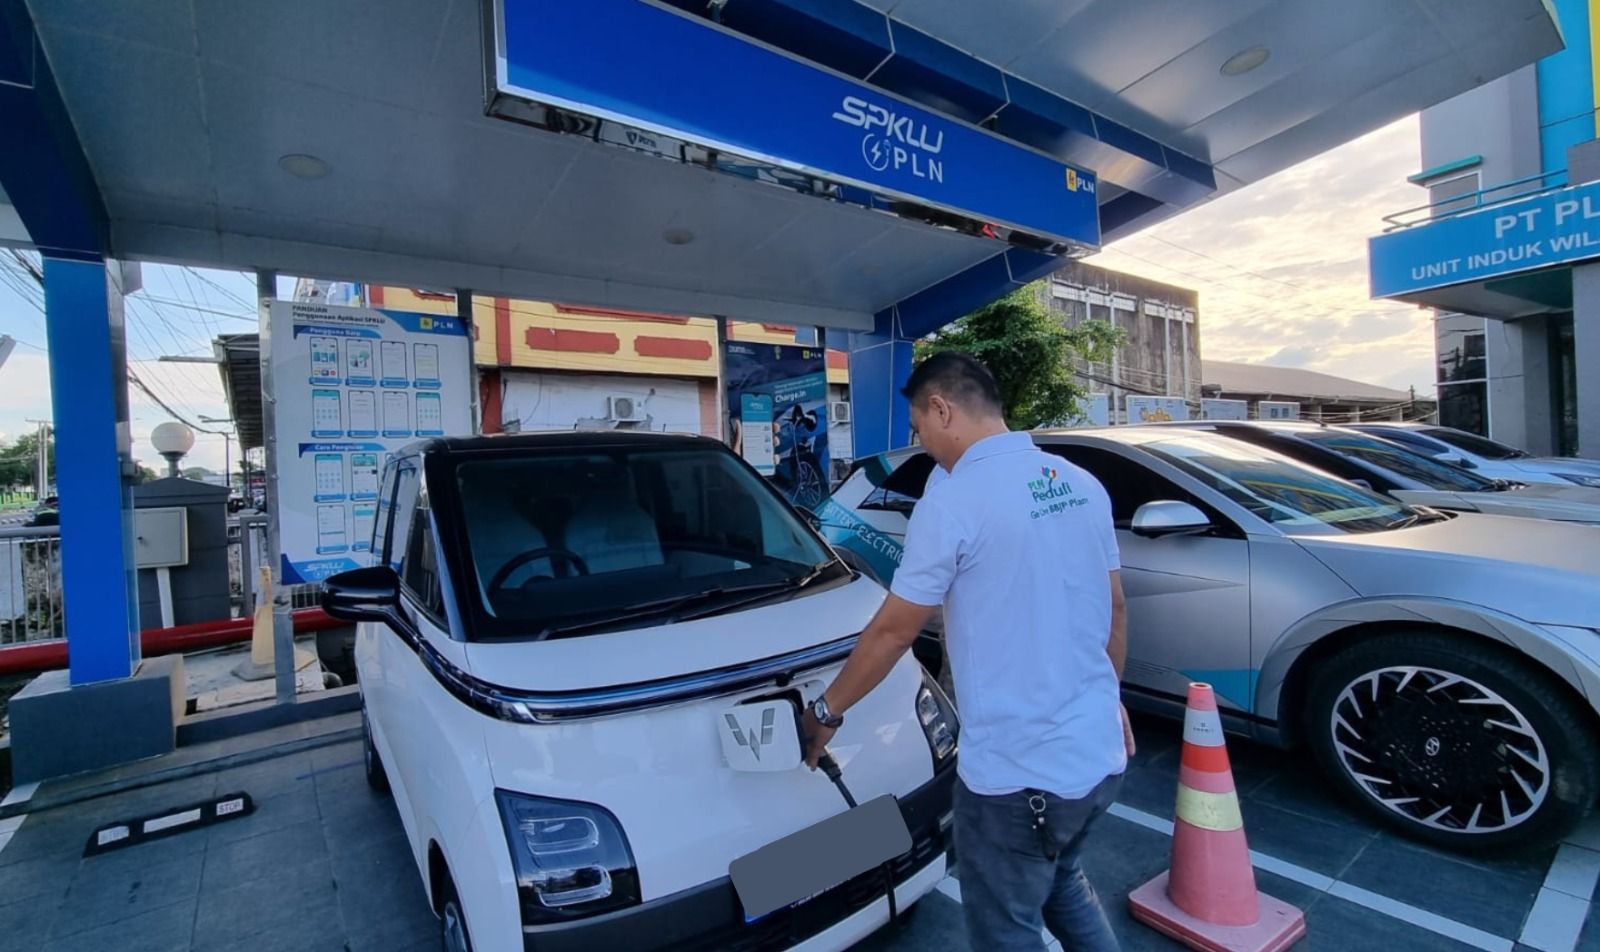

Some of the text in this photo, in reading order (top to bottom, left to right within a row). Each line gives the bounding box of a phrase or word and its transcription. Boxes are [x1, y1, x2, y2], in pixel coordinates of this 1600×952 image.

[832, 96, 944, 154] SPKLU
[894, 148, 944, 184] PLN
[1076, 177, 1095, 193] PLN
[1495, 208, 1542, 238] PT
[1412, 232, 1600, 280] UNIT INDUK WIL
[292, 305, 328, 313] PANDUAN
[293, 312, 336, 320] Penggunaan
[338, 315, 364, 323] Aplikasi
[433, 319, 454, 329] PLN
[310, 327, 344, 335] Pengguna
[1028, 479, 1045, 491] PLN
[218, 801, 241, 814] STOP
